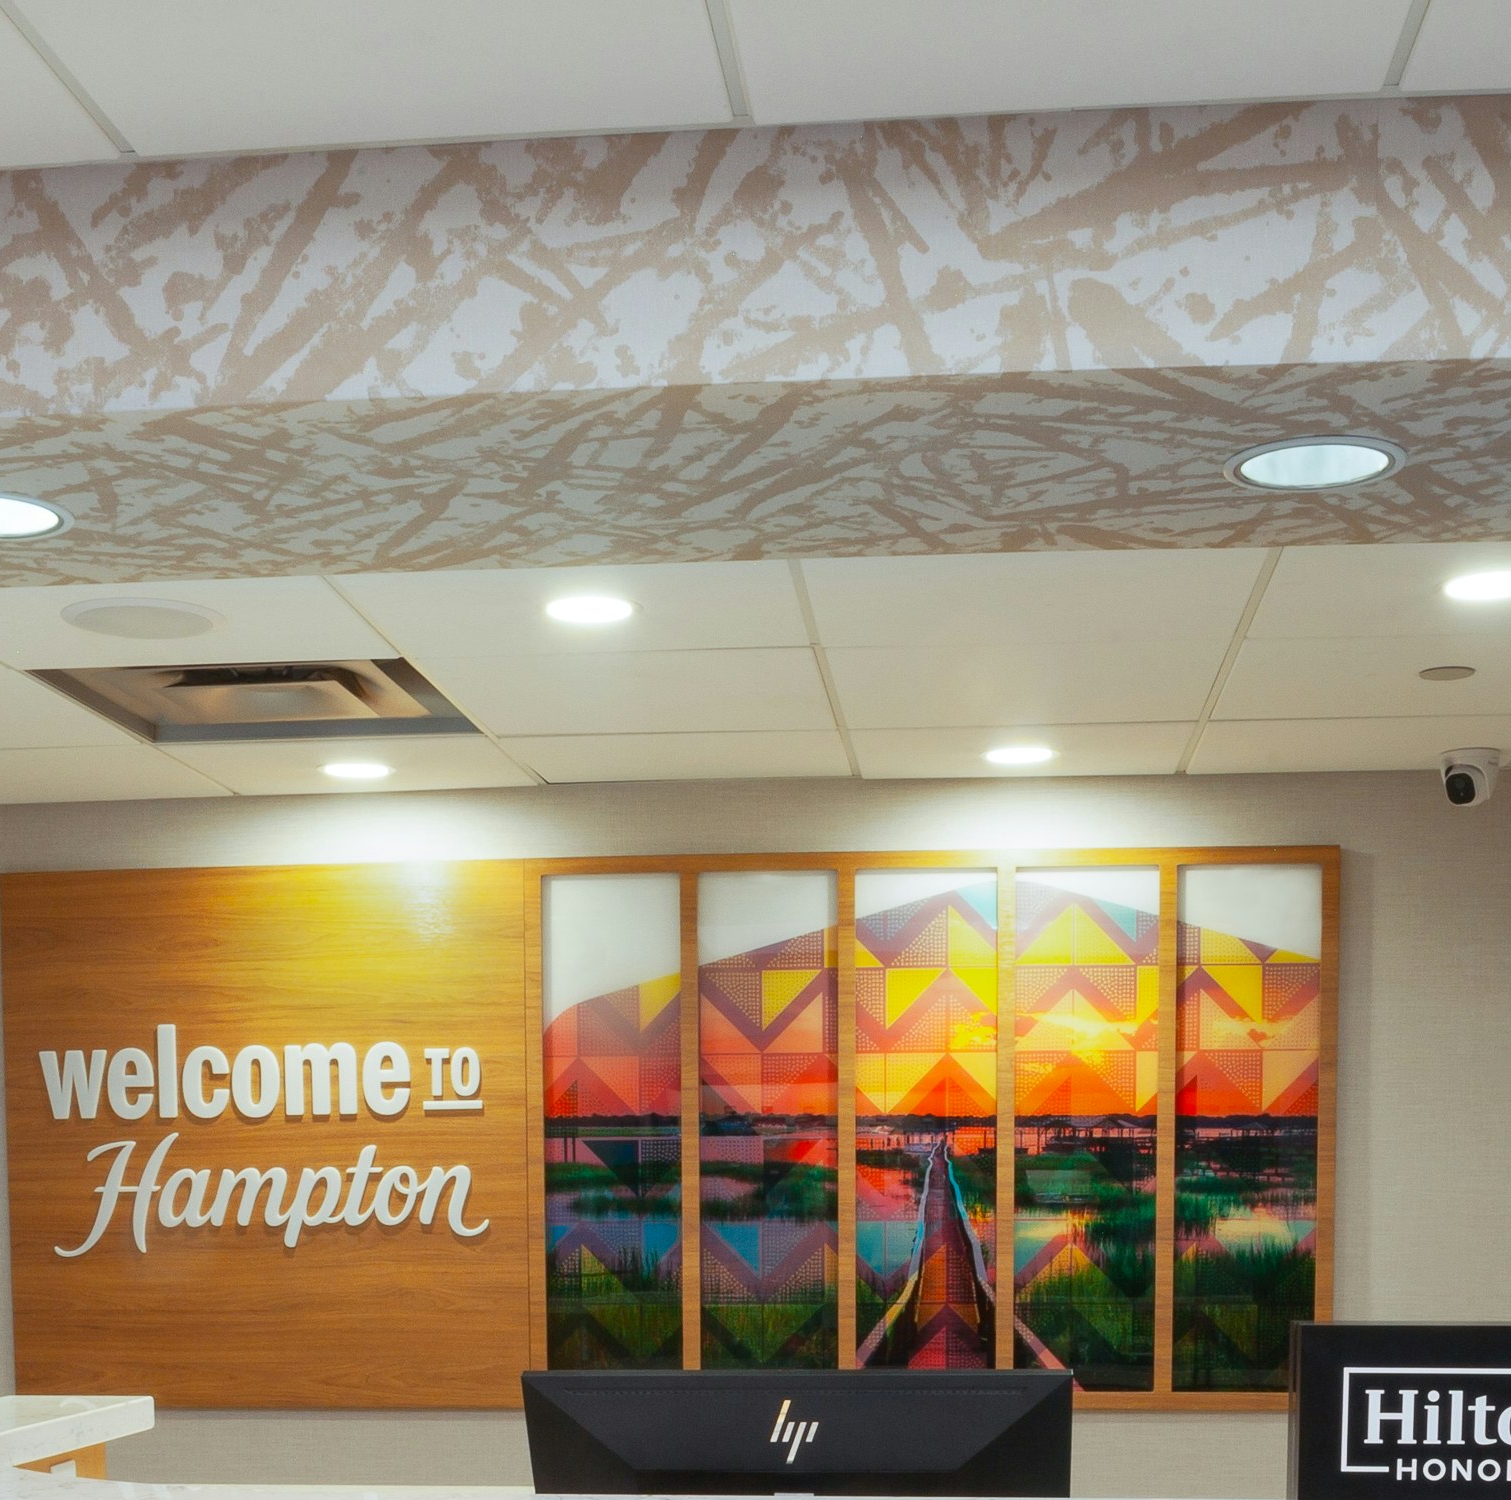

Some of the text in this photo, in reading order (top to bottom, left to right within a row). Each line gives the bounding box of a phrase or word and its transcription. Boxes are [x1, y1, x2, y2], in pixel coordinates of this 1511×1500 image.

[39, 1023, 482, 1120] welcome TO
[54, 1132, 490, 1257] Hampton
[769, 1399, 820, 1465] hp
